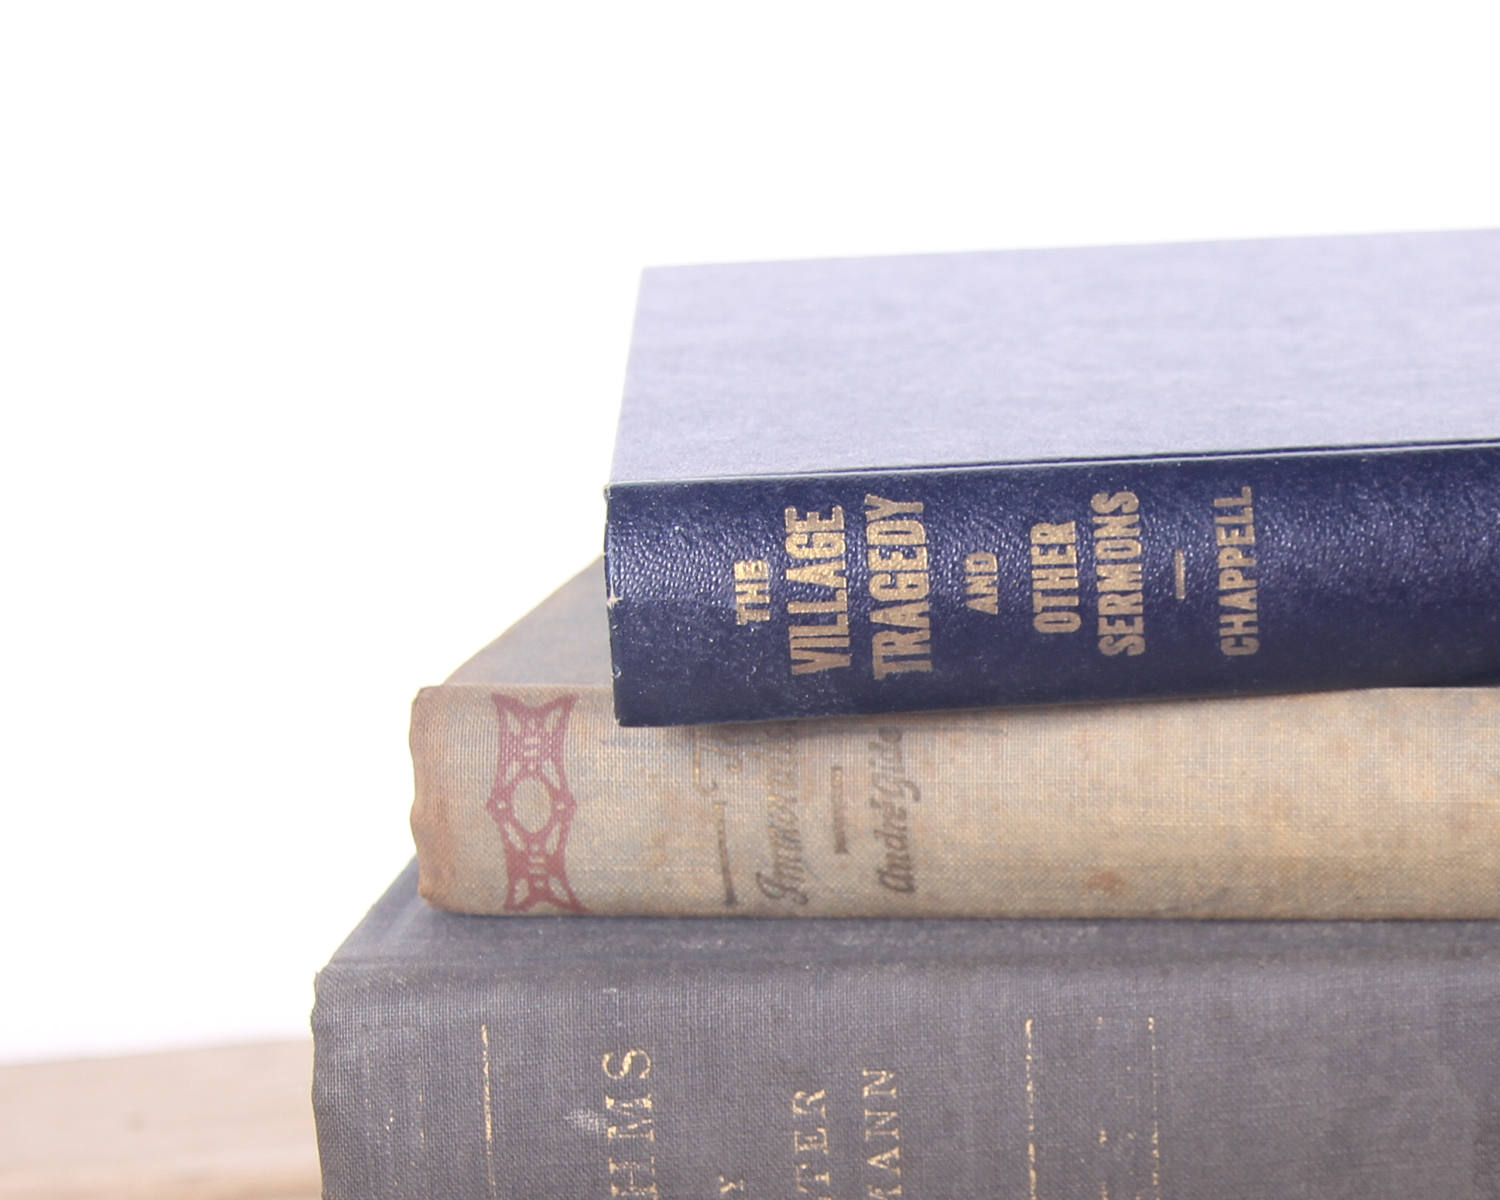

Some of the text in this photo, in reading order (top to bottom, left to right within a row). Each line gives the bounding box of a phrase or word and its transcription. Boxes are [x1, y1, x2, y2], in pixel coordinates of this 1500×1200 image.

[734, 559, 771, 625] THE
[785, 505, 852, 675] VILLAGE
[864, 494, 932, 680] TRAGEDY
[965, 551, 998, 615] AND
[1030, 521, 1082, 633] OTHER
[1091, 490, 1146, 656] SERMONS
[1213, 486, 1260, 656] CHAPPELL
